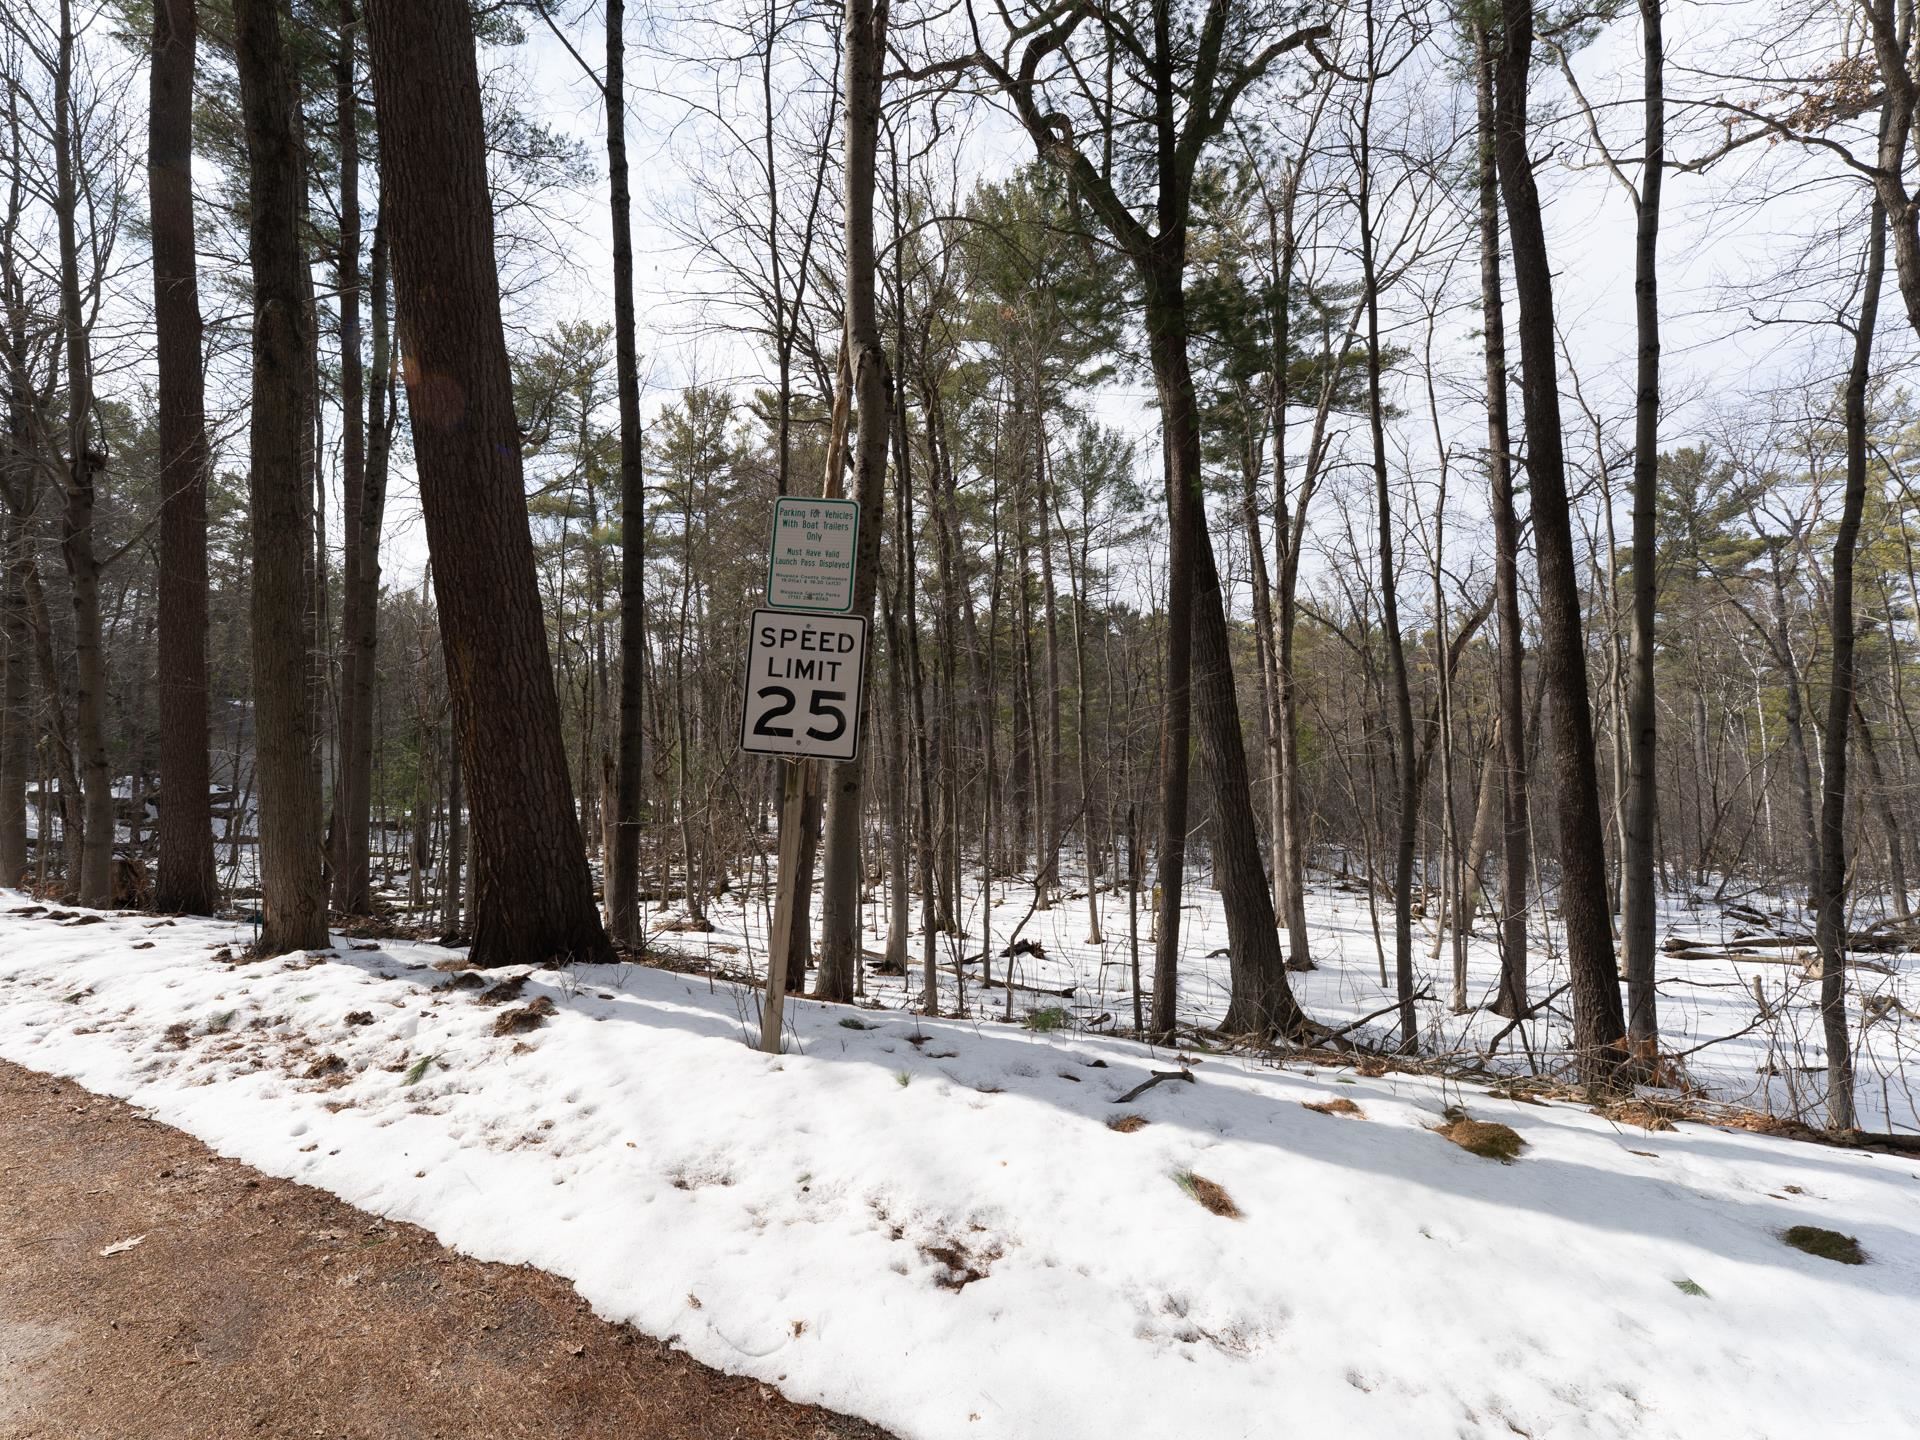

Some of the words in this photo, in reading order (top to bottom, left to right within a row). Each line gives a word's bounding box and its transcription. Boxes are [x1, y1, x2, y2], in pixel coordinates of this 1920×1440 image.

[779, 507, 806, 519] Parking
[825, 509, 854, 520] Vehicles
[782, 519, 798, 528] With
[802, 520, 819, 530] Boat
[823, 521, 849, 531] Trailers
[806, 531, 823, 543] Only
[786, 547, 803, 557] Must
[806, 549, 821, 558] Have
[825, 549, 840, 558] Valid
[775, 557, 798, 566] Launch
[801, 559, 816, 568] Pass
[819, 559, 850, 570] Displayed
[760, 626, 855, 654] SPEED
[767, 656, 842, 682] LIMIT
[752, 685, 847, 742] 25
